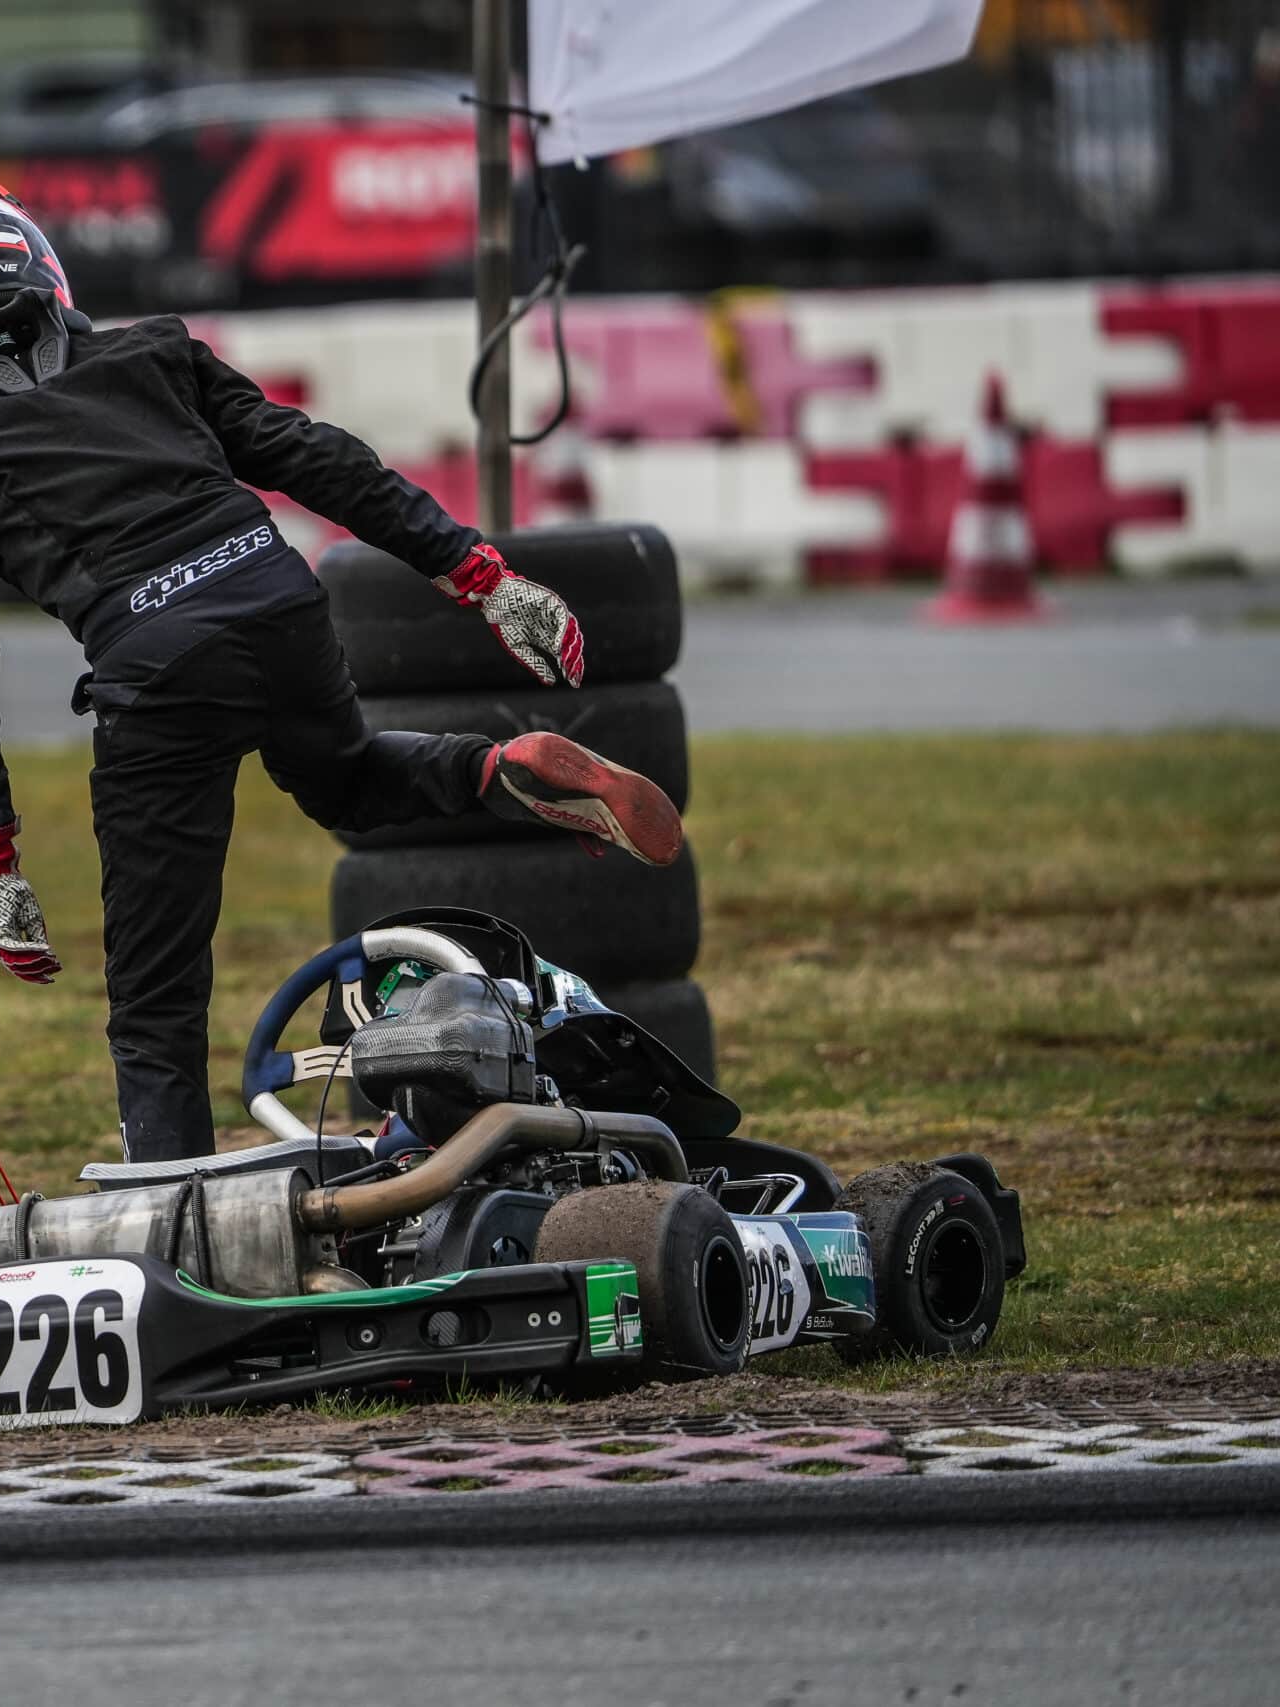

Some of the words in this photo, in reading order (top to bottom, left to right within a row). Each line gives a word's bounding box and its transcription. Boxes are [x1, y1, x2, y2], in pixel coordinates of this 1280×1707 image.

[130, 525, 273, 613] alpinestars
[745, 1243, 794, 1340] 226
[905, 1221, 930, 1275] LECONT
